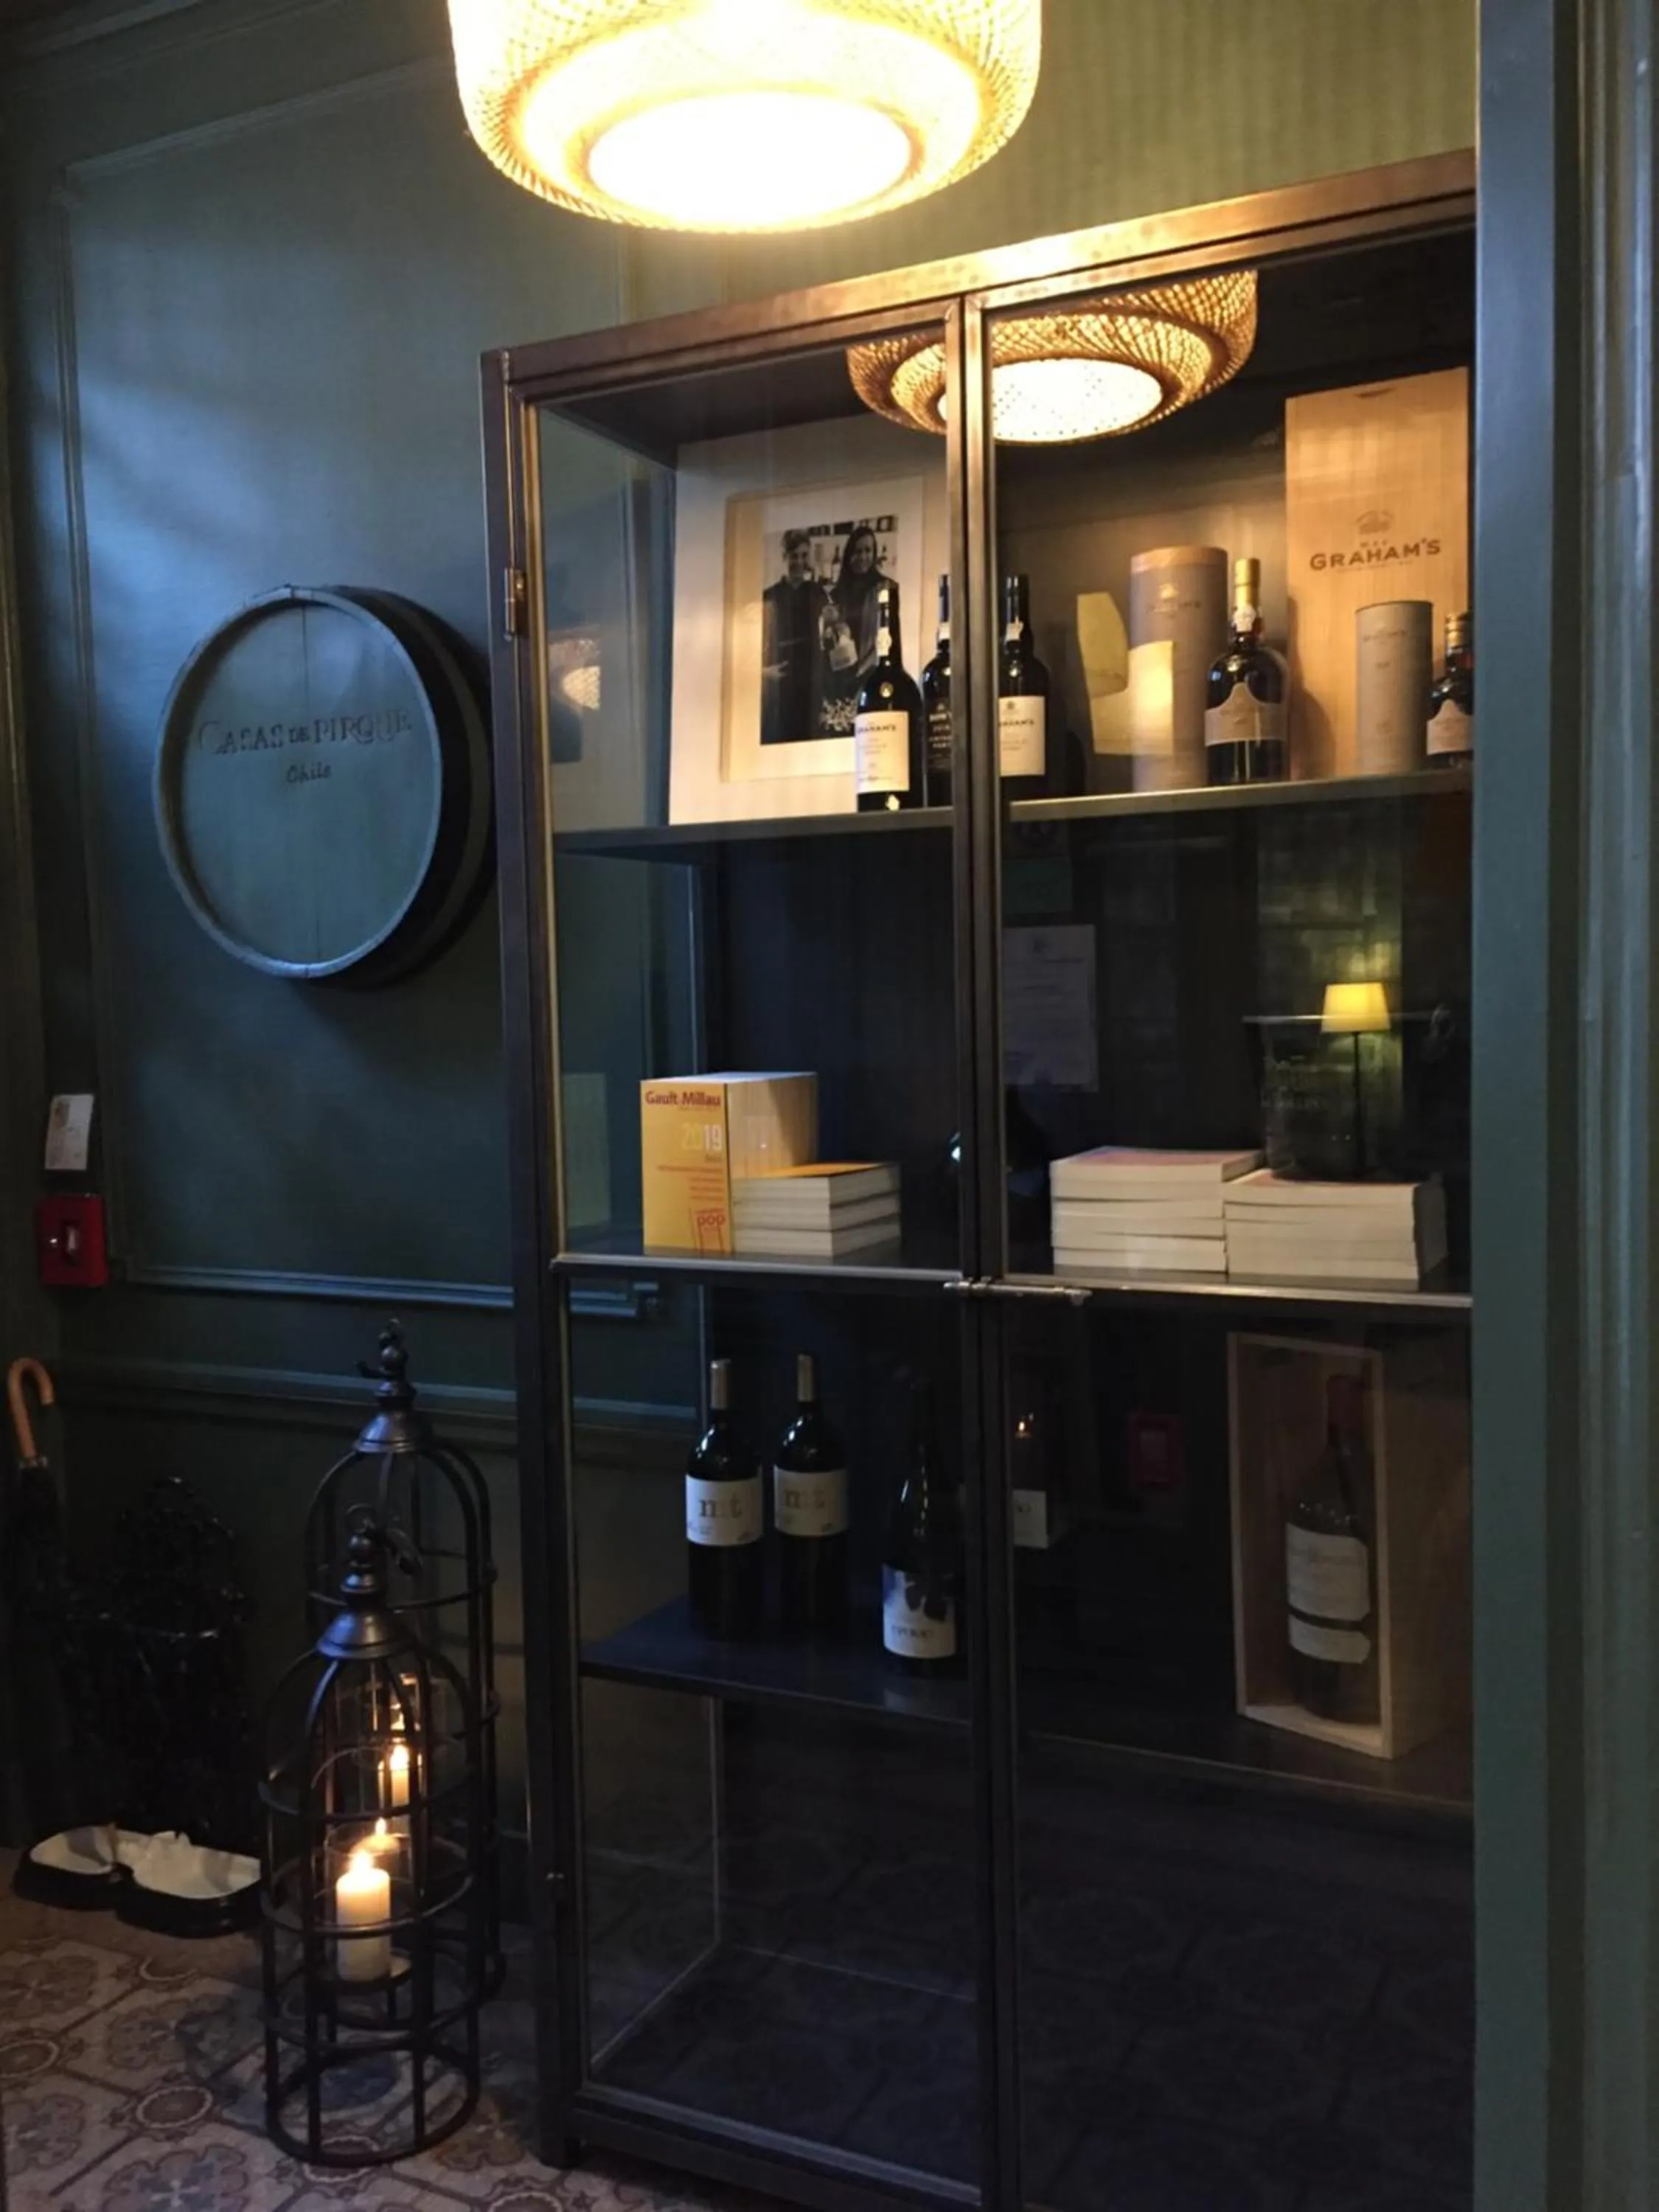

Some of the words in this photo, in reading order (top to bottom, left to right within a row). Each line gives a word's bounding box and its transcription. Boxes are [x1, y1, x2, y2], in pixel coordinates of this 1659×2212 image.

[1309, 538, 1441, 571] GRAHAM'S
[198, 720, 285, 756] CASAS
[313, 708, 413, 745] PIRQUE
[285, 760, 332, 785] Chile
[644, 1090, 678, 1106] Gault
[681, 1091, 722, 1107] Millau
